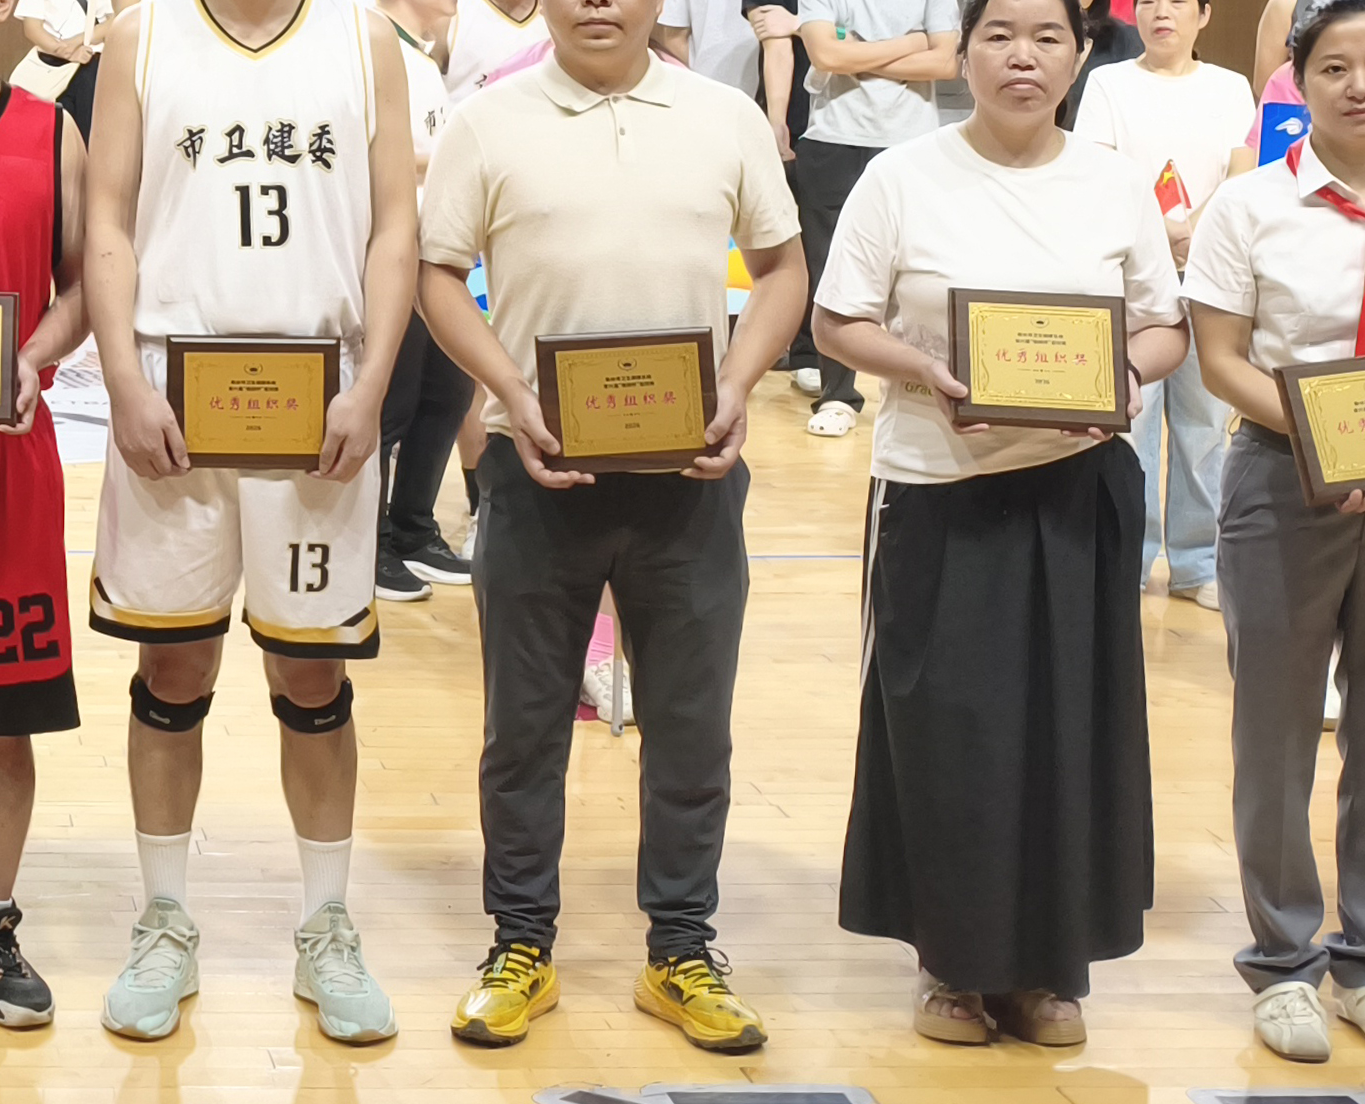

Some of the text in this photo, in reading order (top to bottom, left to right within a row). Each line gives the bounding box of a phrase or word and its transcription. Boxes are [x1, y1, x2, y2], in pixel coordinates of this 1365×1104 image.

[176, 121, 336, 171] 市卫健委
[234, 184, 290, 247] 13
[288, 543, 330, 592] 13
